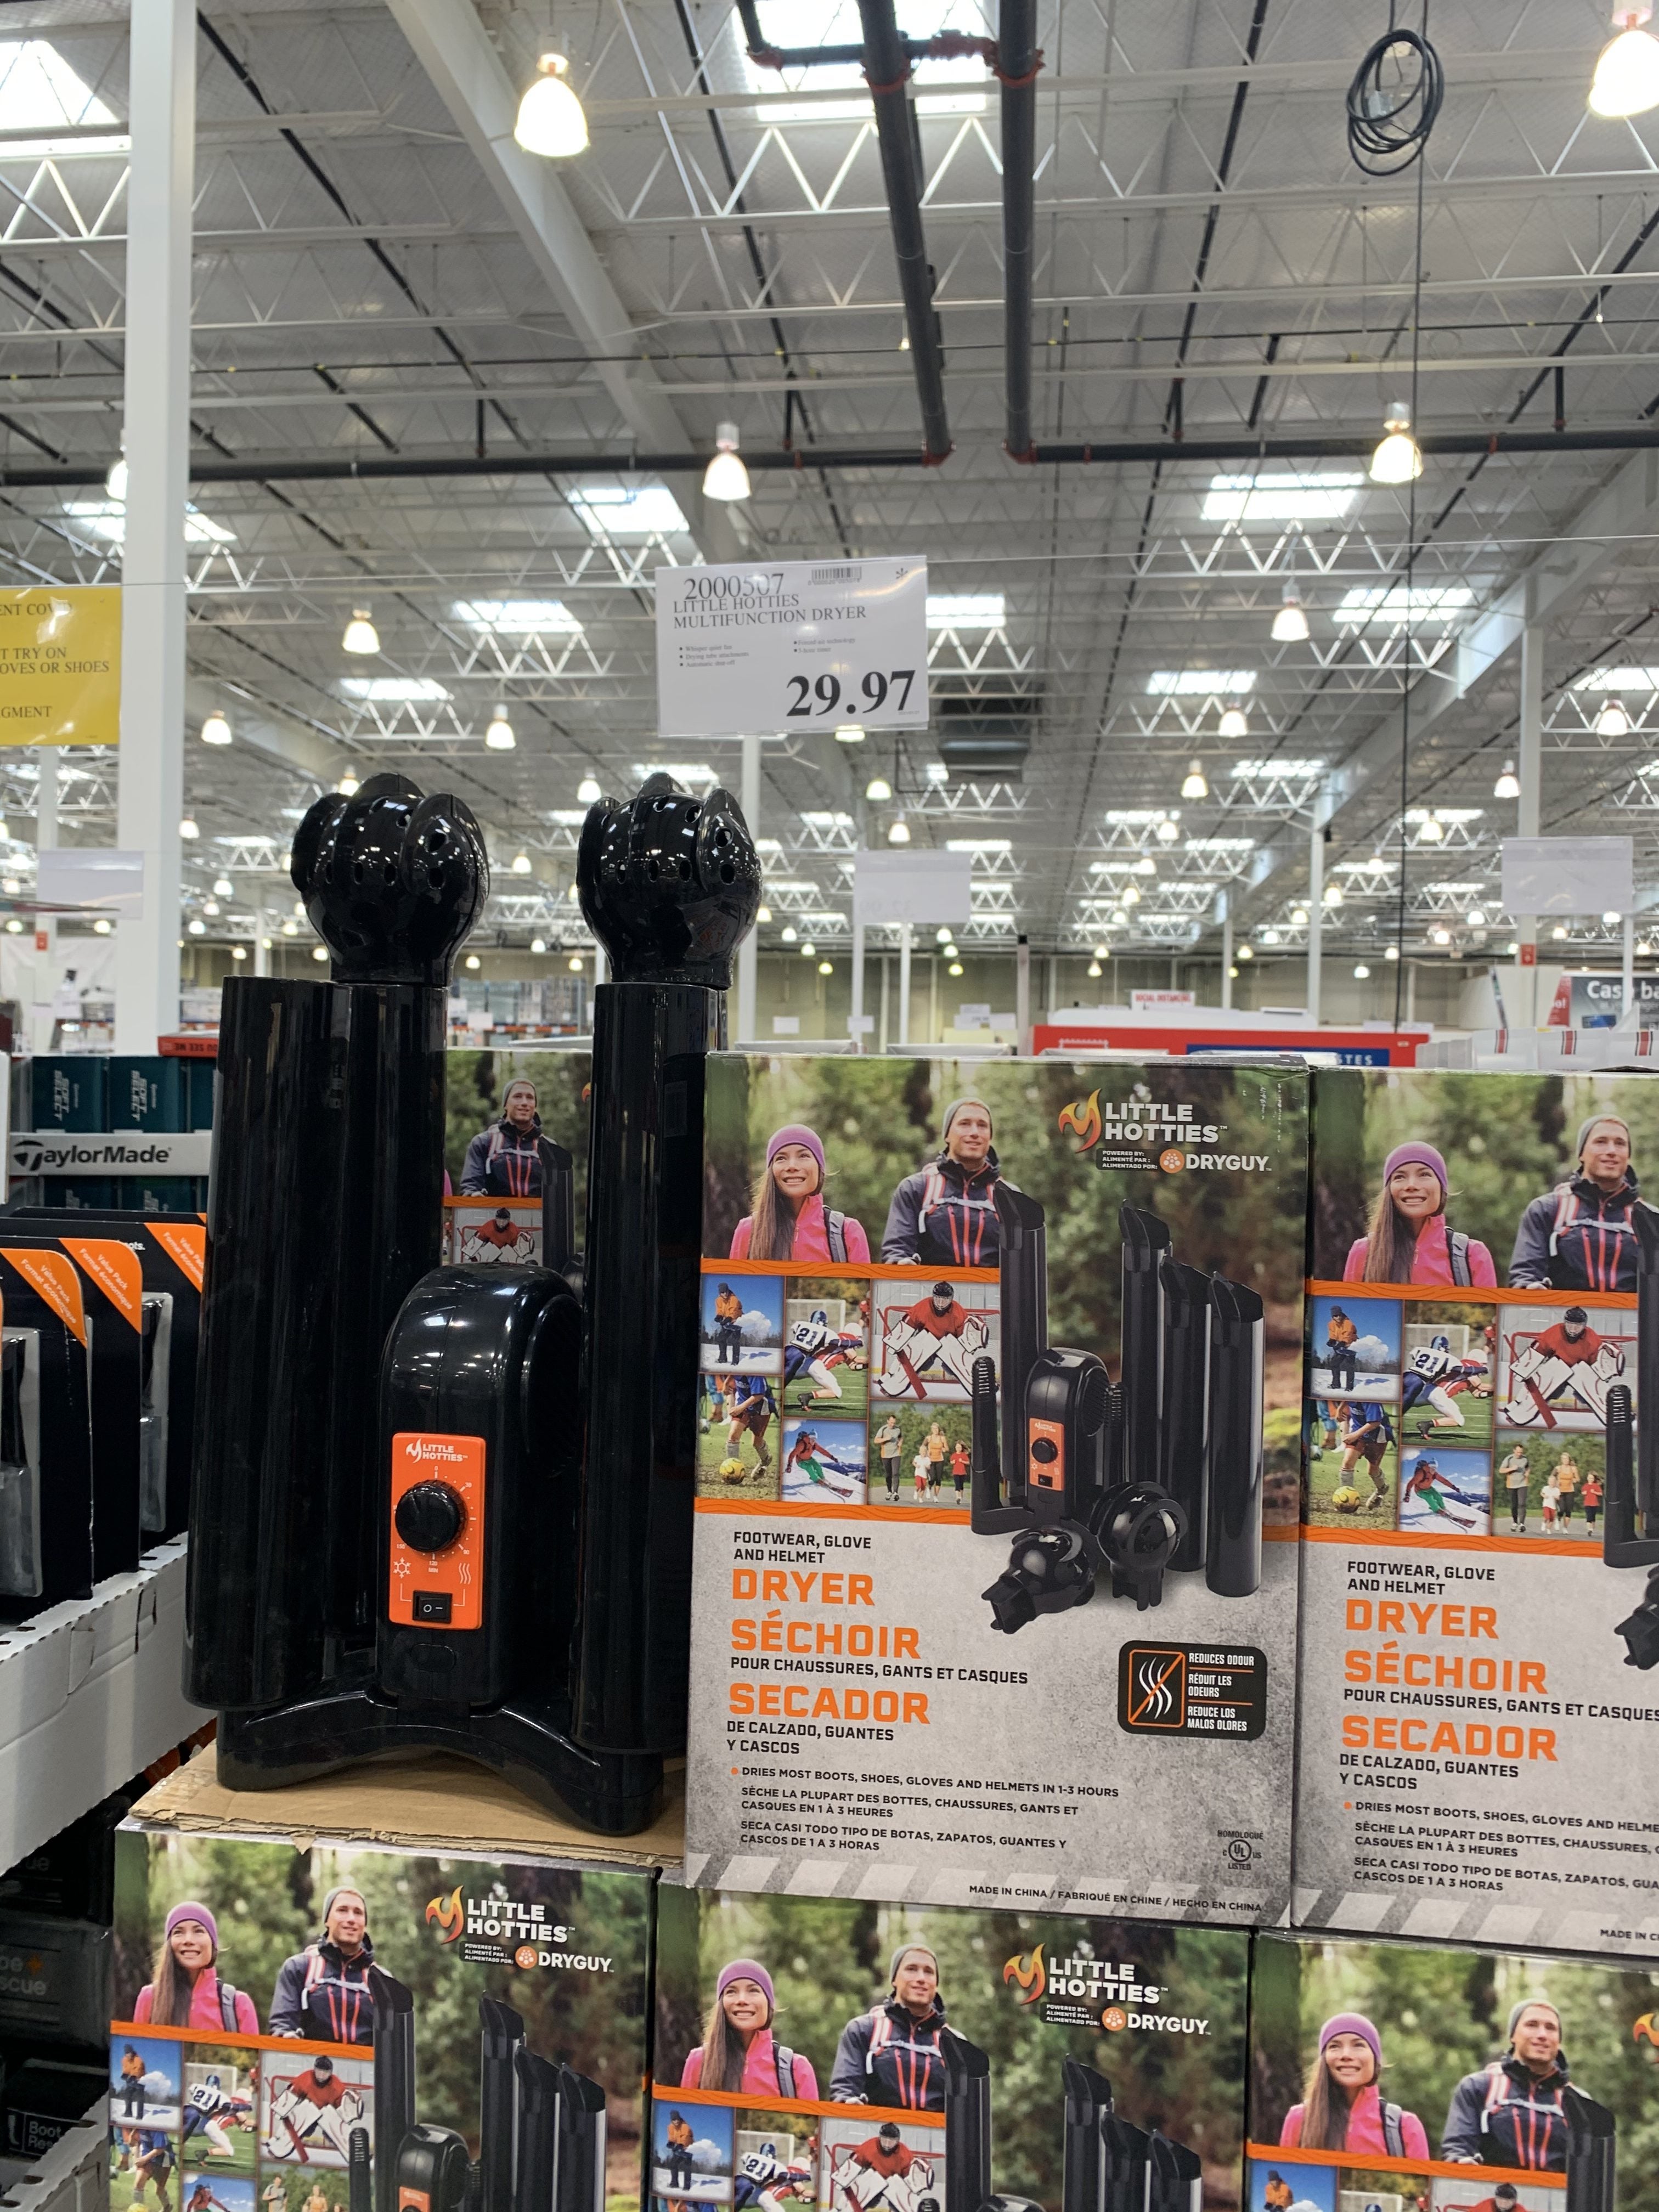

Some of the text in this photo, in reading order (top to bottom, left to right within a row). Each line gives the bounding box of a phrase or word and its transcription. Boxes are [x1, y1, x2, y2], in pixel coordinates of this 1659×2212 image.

[674, 594, 799, 613] LITTLE HOTTIES
[674, 606, 866, 629] MULTIFUNCTION DRYER
[13, 647, 66, 659] TRY ON
[41, 662, 59, 674] OR
[64, 661, 109, 673] SHOES
[786, 670, 915, 717] 29.97
[1587, 980, 1634, 998] Cas
[1106, 1103, 1193, 1122] LITTLE
[80, 1248, 100, 1272] Format
[97, 1254, 128, 1290] Value Pack
[797, 1328, 819, 1346] 21
[423, 1443, 454, 1453] LITTLE
[733, 1531, 871, 1549] FOOTWEAR, GLOVE
[733, 1548, 826, 1564] AND HELMET
[1347, 1561, 1495, 1581] FOOTWEAR, GLOVE
[732, 1568, 874, 1606] DRYER
[1347, 1578, 1446, 1595] AND HELMET
[1346, 1599, 1498, 1639] DRYER
[731, 1609, 921, 1659] SÉCHOIR
[1189, 1652, 1254, 1666] REDUCES ODOUR
[1345, 1640, 1547, 1694] SÉCHOIR
[731, 1657, 1028, 1684] POUR CHAUSSURES, GANTS ET CASQUES
[1188, 1672, 1232, 1686] RÉDUIT LES
[1188, 1686, 1220, 1697] ODEURS
[729, 1683, 930, 1724] SECADOR
[1188, 1706, 1235, 1719] REDUCE LOS
[1344, 1688, 1659, 1722] POUR CHAUSSURES, GANTS ET CASQUES
[727, 1720, 894, 1741] DE CALZADO, GUANTES
[1187, 1718, 1247, 1731] MALOS OLORES
[726, 1739, 799, 1754] Y CASCOS
[1342, 1715, 1558, 1762] SECADOR
[1340, 1753, 1519, 1778] DE CALZADO, GUANTES
[742, 1767, 1119, 1797] DRIES MOST BOOTS, SHOES, GLOVES AND HELMETS IN 1-3 HOURS
[1339, 1772, 1417, 1790] Y CASCOS
[741, 1785, 1079, 1815] SÈCHE LA PLUPART DES BOTTES, CHAUSSURES, GANTS ET
[741, 1801, 893, 1818] CASQUES EN 1 À 3 HEURES
[740, 1834, 879, 1851] CASCOS DE 1 A 3 HORAS
[741, 1820, 1066, 1849] SECA CASI TODO TIPO DE BOTAS, ZAPATOS, GUANTES Y
[969, 1886, 1261, 1912] MADE IN CHINA FABRIQUÉ EN CHINE HECHO EN CHINA
[467, 1899, 545, 1921] LITTLE
[1050, 1957, 1135, 1982] LITTLE
